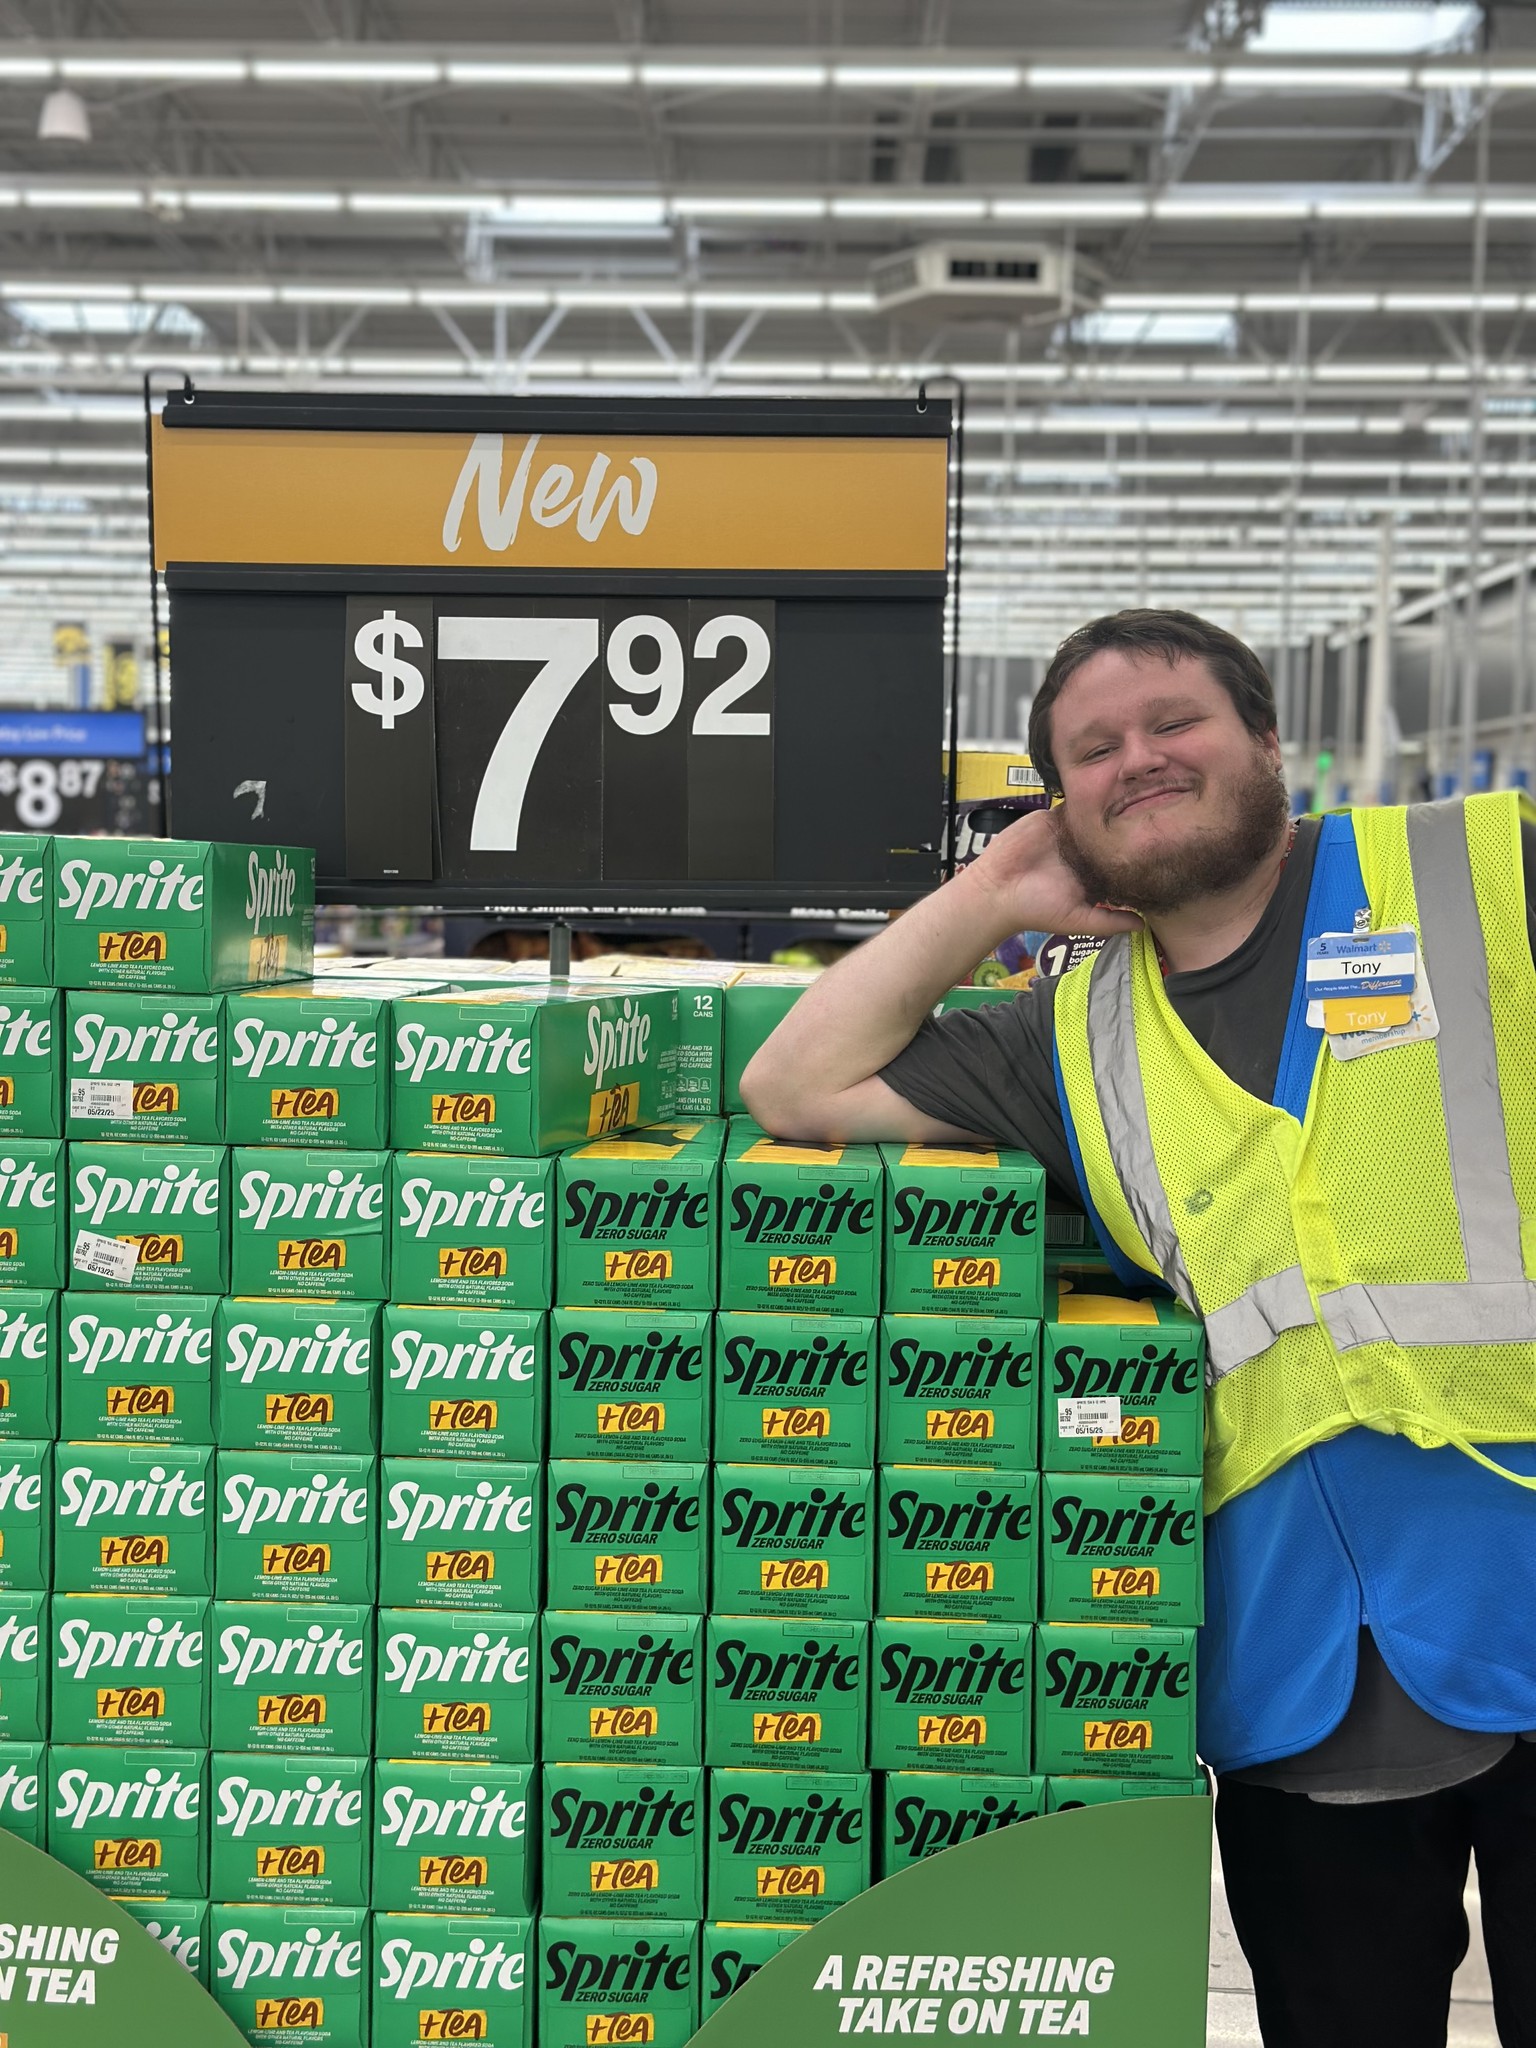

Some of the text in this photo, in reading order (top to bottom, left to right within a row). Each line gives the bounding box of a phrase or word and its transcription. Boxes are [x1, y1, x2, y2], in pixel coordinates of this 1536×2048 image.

[442, 433, 658, 552] New
[59, 860, 203, 919] Sprite
[246, 850, 296, 935] Sprite
[1048, 945, 1067, 976] 1
[1073, 939, 1105, 950] gram of
[1320, 942, 1327, 951] 5
[1336, 943, 1377, 954] Walmart
[1341, 961, 1381, 975] Tony
[693, 995, 713, 1010] 12
[1361, 979, 1402, 991] Difference
[73, 1013, 217, 1073] Sprite
[233, 1018, 376, 1077] Sprite
[584, 998, 651, 1090] Sprite
[1345, 1011, 1387, 1026] Tony
[1361, 1028, 1406, 1044] membership
[395, 1023, 530, 1082] Sprite
[87, 1108, 115, 1117] 05/22/25
[75, 1165, 219, 1224] Sprite
[239, 1170, 383, 1229] Sprite
[400, 1178, 544, 1237] Sprite
[564, 1179, 708, 1239] Sprite
[730, 1184, 873, 1243] Sprite
[893, 1187, 1036, 1246] Sprite
[594, 1229, 667, 1240] ZERO SUGAR
[760, 1234, 833, 1245] ZERO SUGAR
[923, 1237, 996, 1248] ZERO SUGAR
[87, 1263, 114, 1277] 05/13/25
[69, 1314, 211, 1373] Sprite
[226, 1324, 370, 1383] Sprite
[390, 1331, 534, 1390] Sprite
[558, 1332, 702, 1392] Sprite
[723, 1336, 867, 1396] Sprite
[888, 1338, 1032, 1398] Sprite
[1053, 1345, 1198, 1399] Sprite
[588, 1382, 661, 1393] ZERO SUGAR
[753, 1386, 826, 1397] ZERO SUGAR
[918, 1388, 991, 1399] ZERO SUGAR
[1065, 1408, 1073, 1416] 95
[1075, 1426, 1104, 1435] 05/15/25
[60, 1467, 204, 1526] Sprite
[223, 1474, 367, 1534] Sprite
[388, 1482, 532, 1541] Sprite
[555, 1483, 699, 1543] Sprite
[721, 1488, 865, 1548] Sprite
[887, 1490, 1031, 1550] Sprite
[1051, 1496, 1195, 1556] Sprite
[1081, 1546, 1154, 1557] ZERO SUGAR
[58, 1618, 202, 1678] Sprite
[219, 1626, 362, 1685] Sprite
[385, 1633, 528, 1692] Sprite
[549, 1635, 693, 1695] Sprite
[714, 1640, 858, 1700] Sprite
[880, 1644, 1024, 1704] Sprite
[579, 1685, 652, 1696] ZERO SUGAR
[1045, 1648, 1189, 1709] Sprite
[1075, 1698, 1148, 1709] ZERO SUGAR
[56, 1769, 199, 1828] Sprite
[217, 1776, 361, 1836] Sprite
[381, 1786, 525, 1846] Sprite
[550, 1787, 694, 1849] Sprite
[718, 1794, 862, 1854] Sprite
[580, 1837, 653, 1848] ZERO SUGAR
[25, 1967, 96, 2005] TEA
[218, 1928, 361, 1988] Sprite
[380, 1939, 524, 1999] Sprite
[545, 1941, 689, 2002] Sprite
[813, 1955, 1115, 1994] A REFRESHING
[575, 1991, 648, 2002] ZERO SUGAR
[838, 1997, 1089, 2035] TAKE ON TEA
